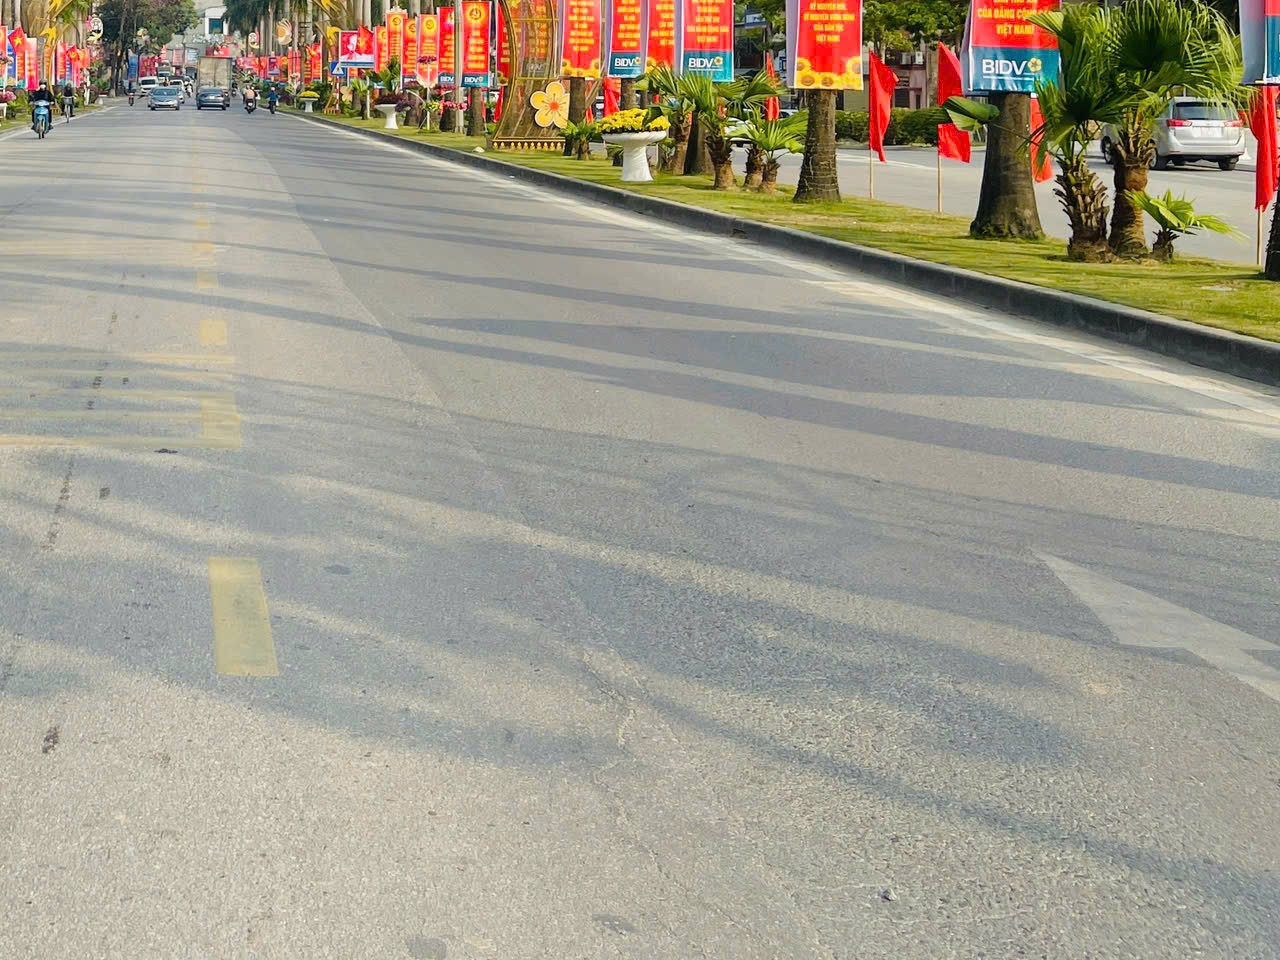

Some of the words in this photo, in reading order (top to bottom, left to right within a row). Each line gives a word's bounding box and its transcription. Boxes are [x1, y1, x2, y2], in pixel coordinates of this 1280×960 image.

[996, 23, 1013, 36] VIỆT
[614, 58, 634, 67] BIDV
[688, 58, 714, 68] BIDV
[982, 59, 1028, 75] BIDV
